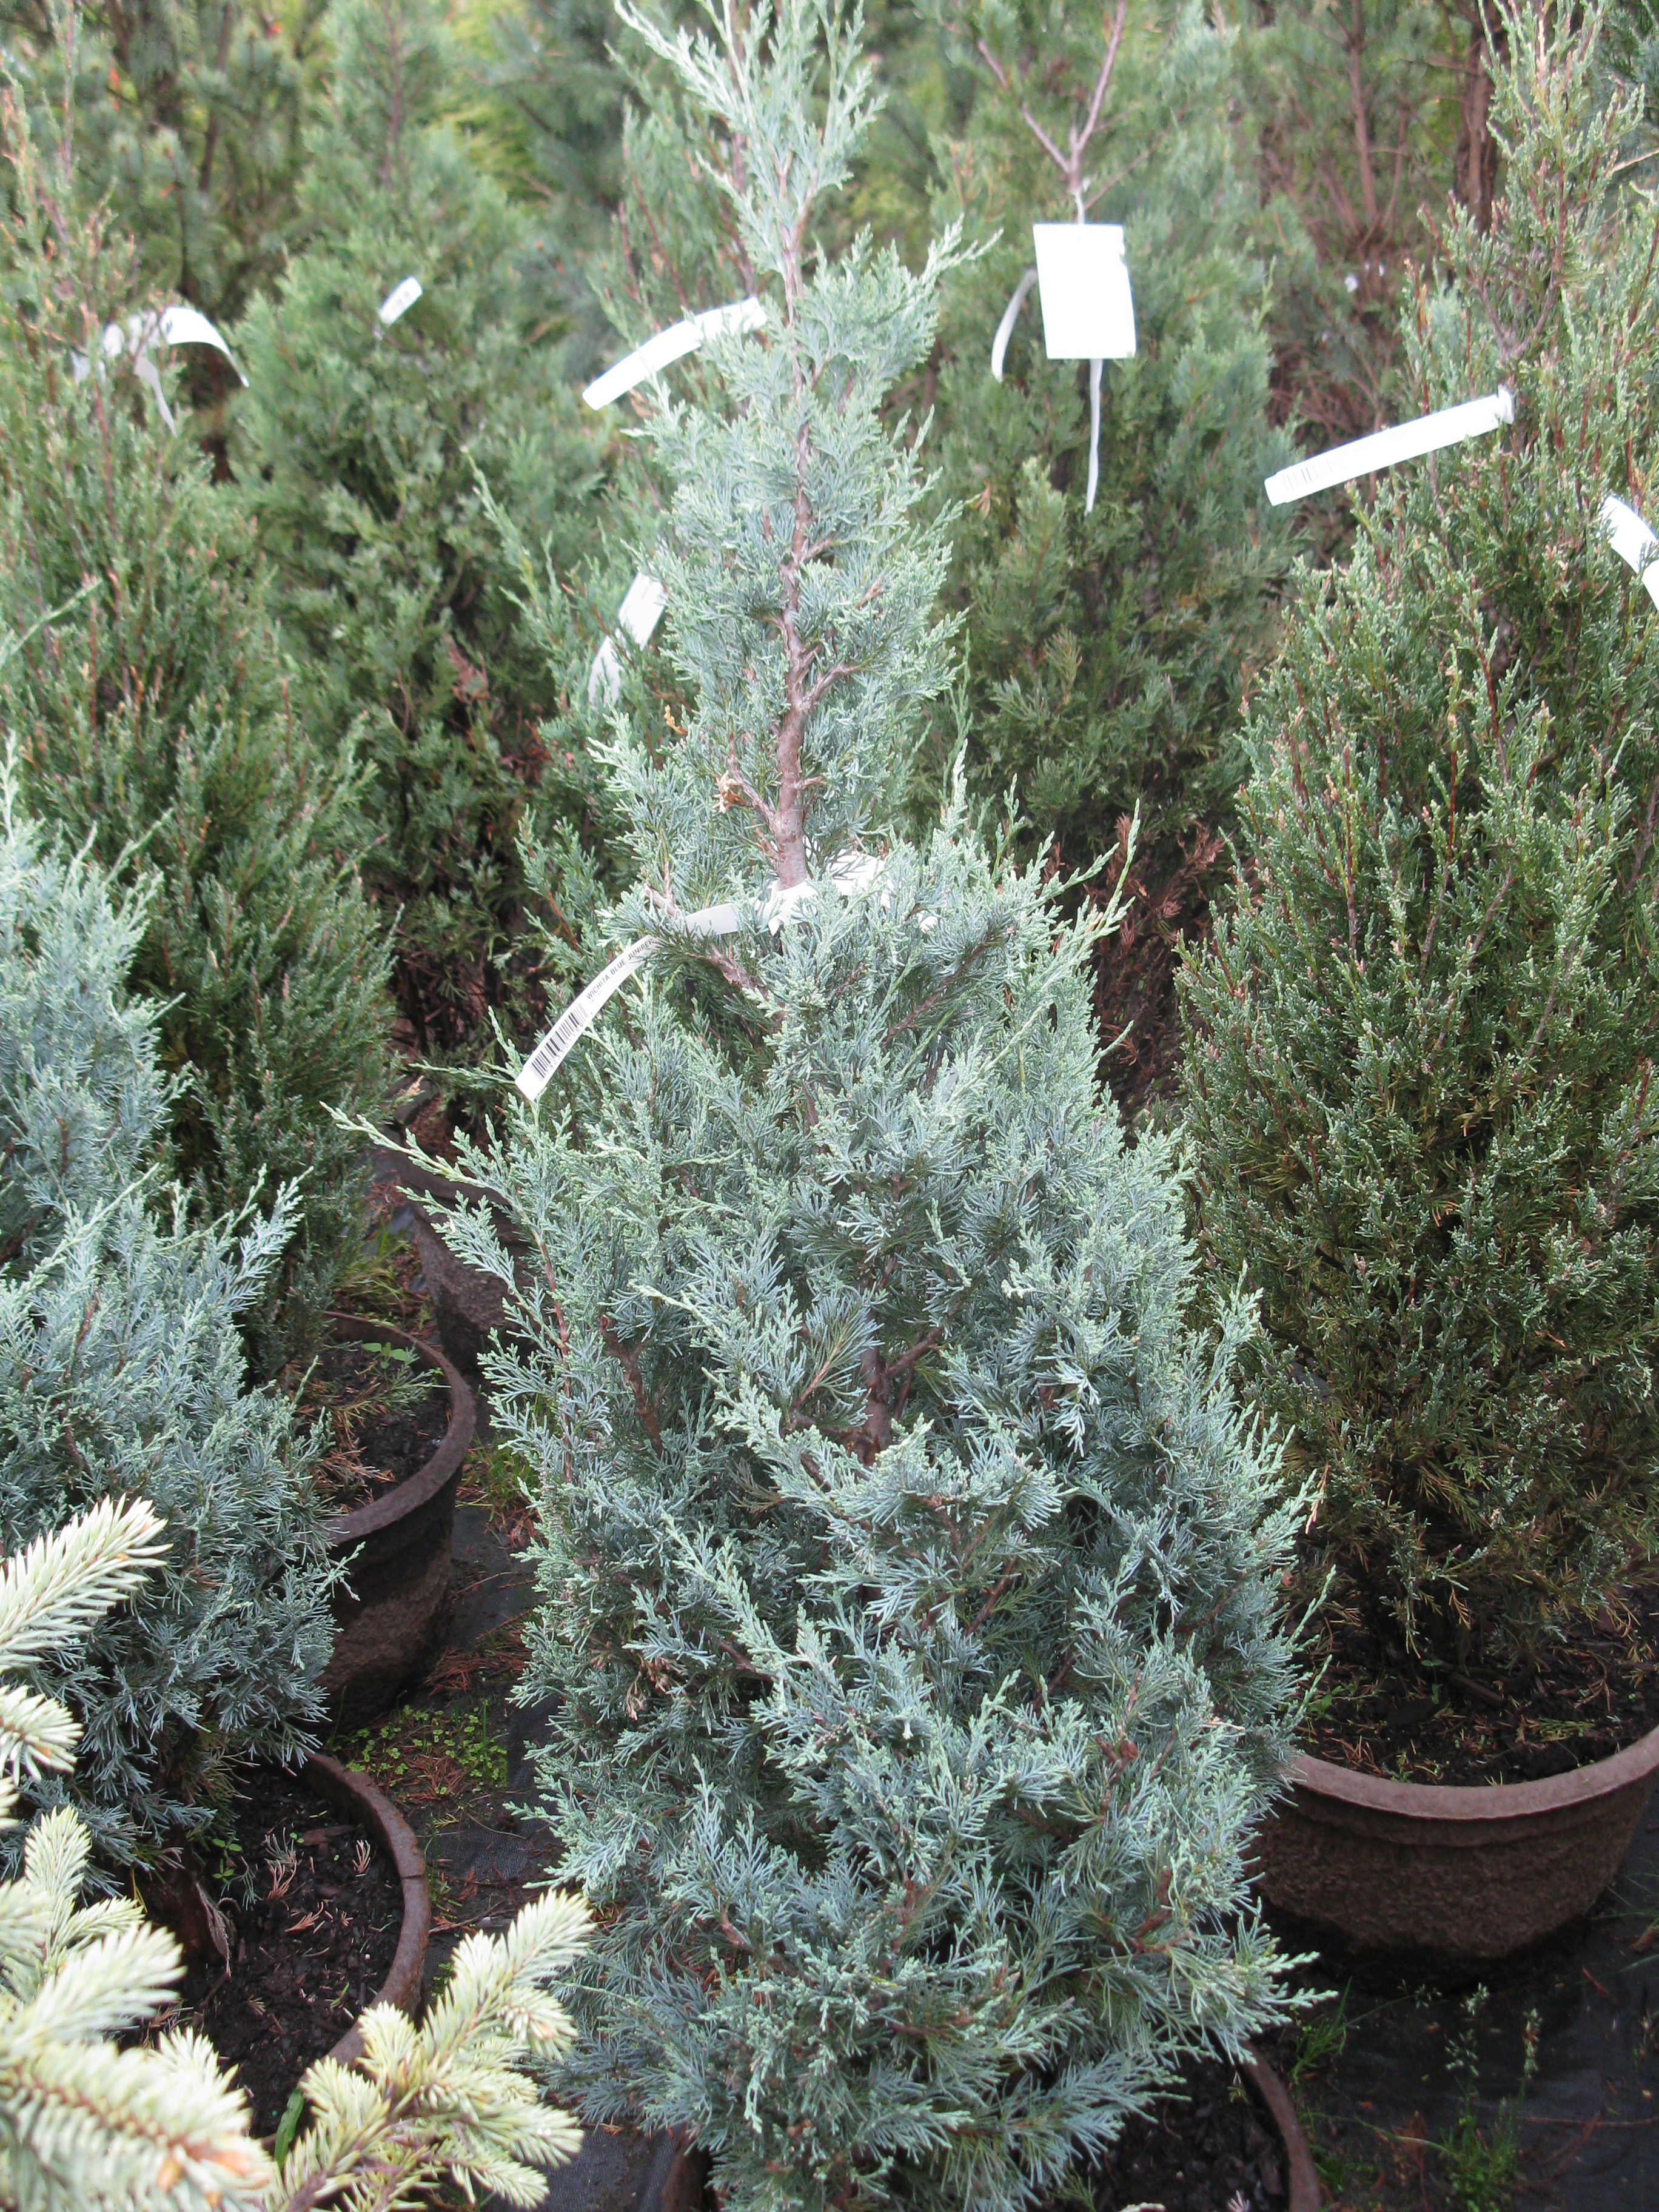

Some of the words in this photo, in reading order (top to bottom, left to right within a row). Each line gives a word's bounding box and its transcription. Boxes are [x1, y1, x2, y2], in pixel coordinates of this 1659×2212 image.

[586, 974, 610, 1000] WICHITA
[610, 959, 626, 975] BLUE
[627, 938, 654, 961] JUNIPER
